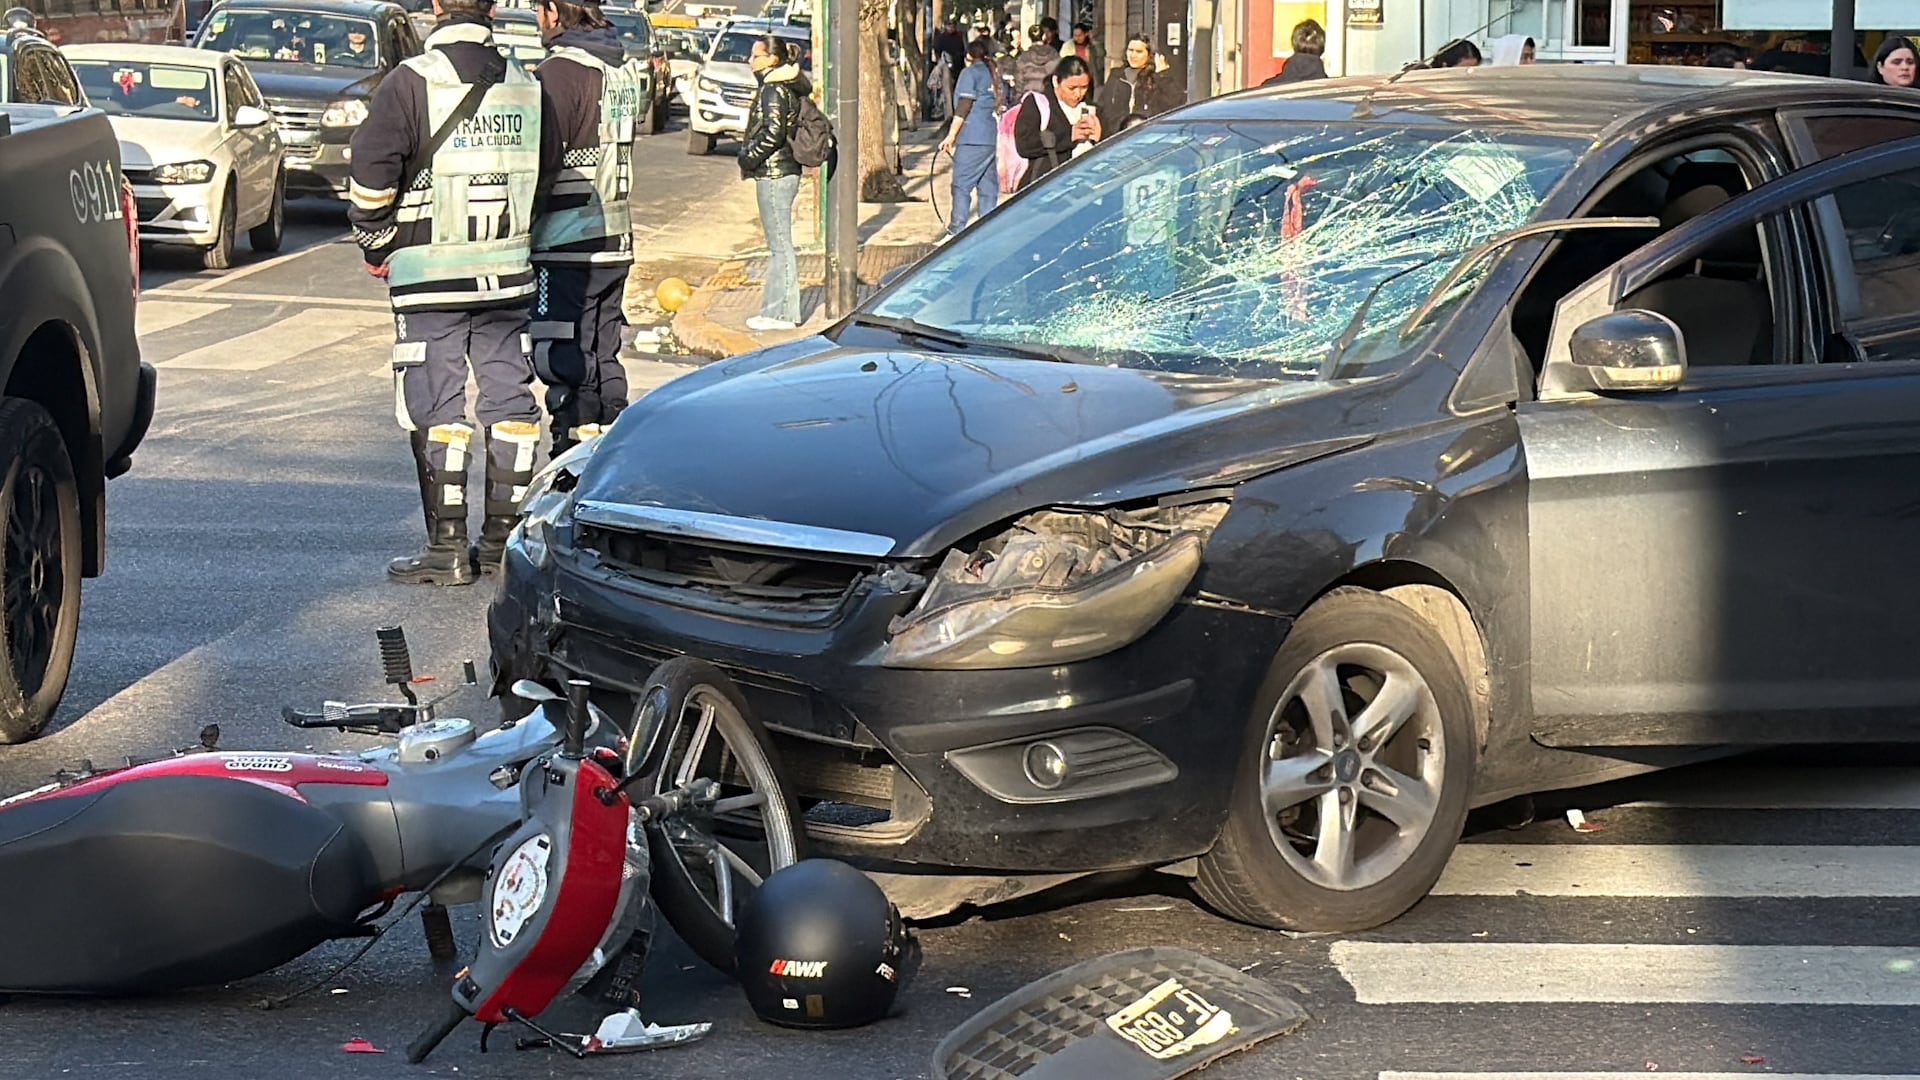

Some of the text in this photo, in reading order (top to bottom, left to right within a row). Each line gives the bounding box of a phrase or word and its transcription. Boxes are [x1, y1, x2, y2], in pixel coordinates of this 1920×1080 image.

[454, 135, 522, 147] DE LA CIUDAD
[227, 761, 291, 771] CIUDAD
[769, 959, 828, 978] HAWK
[1122, 1011, 1185, 1051] 894
